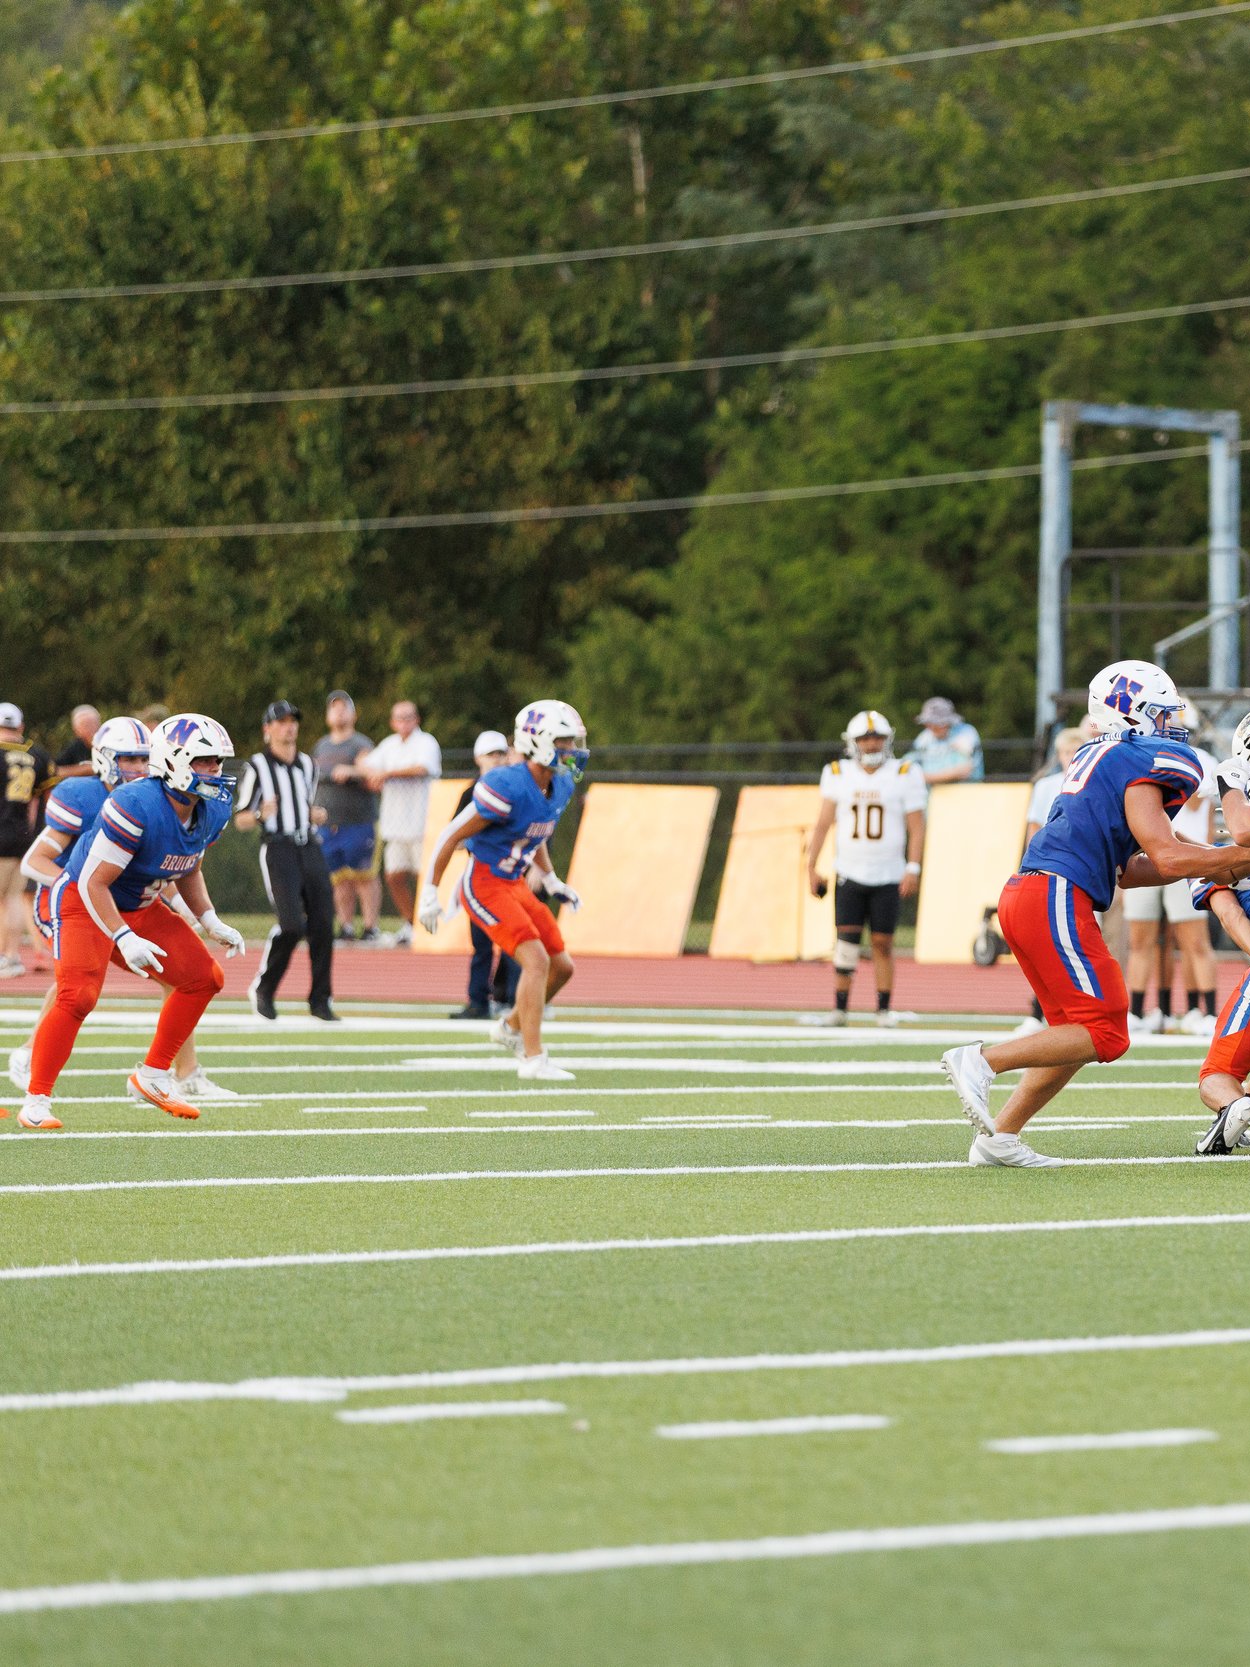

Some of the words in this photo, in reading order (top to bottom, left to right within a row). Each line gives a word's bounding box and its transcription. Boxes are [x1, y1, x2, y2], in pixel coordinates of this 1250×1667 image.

[1103, 675, 1145, 716] N
[165, 718, 200, 748] N
[851, 803, 884, 841] 10
